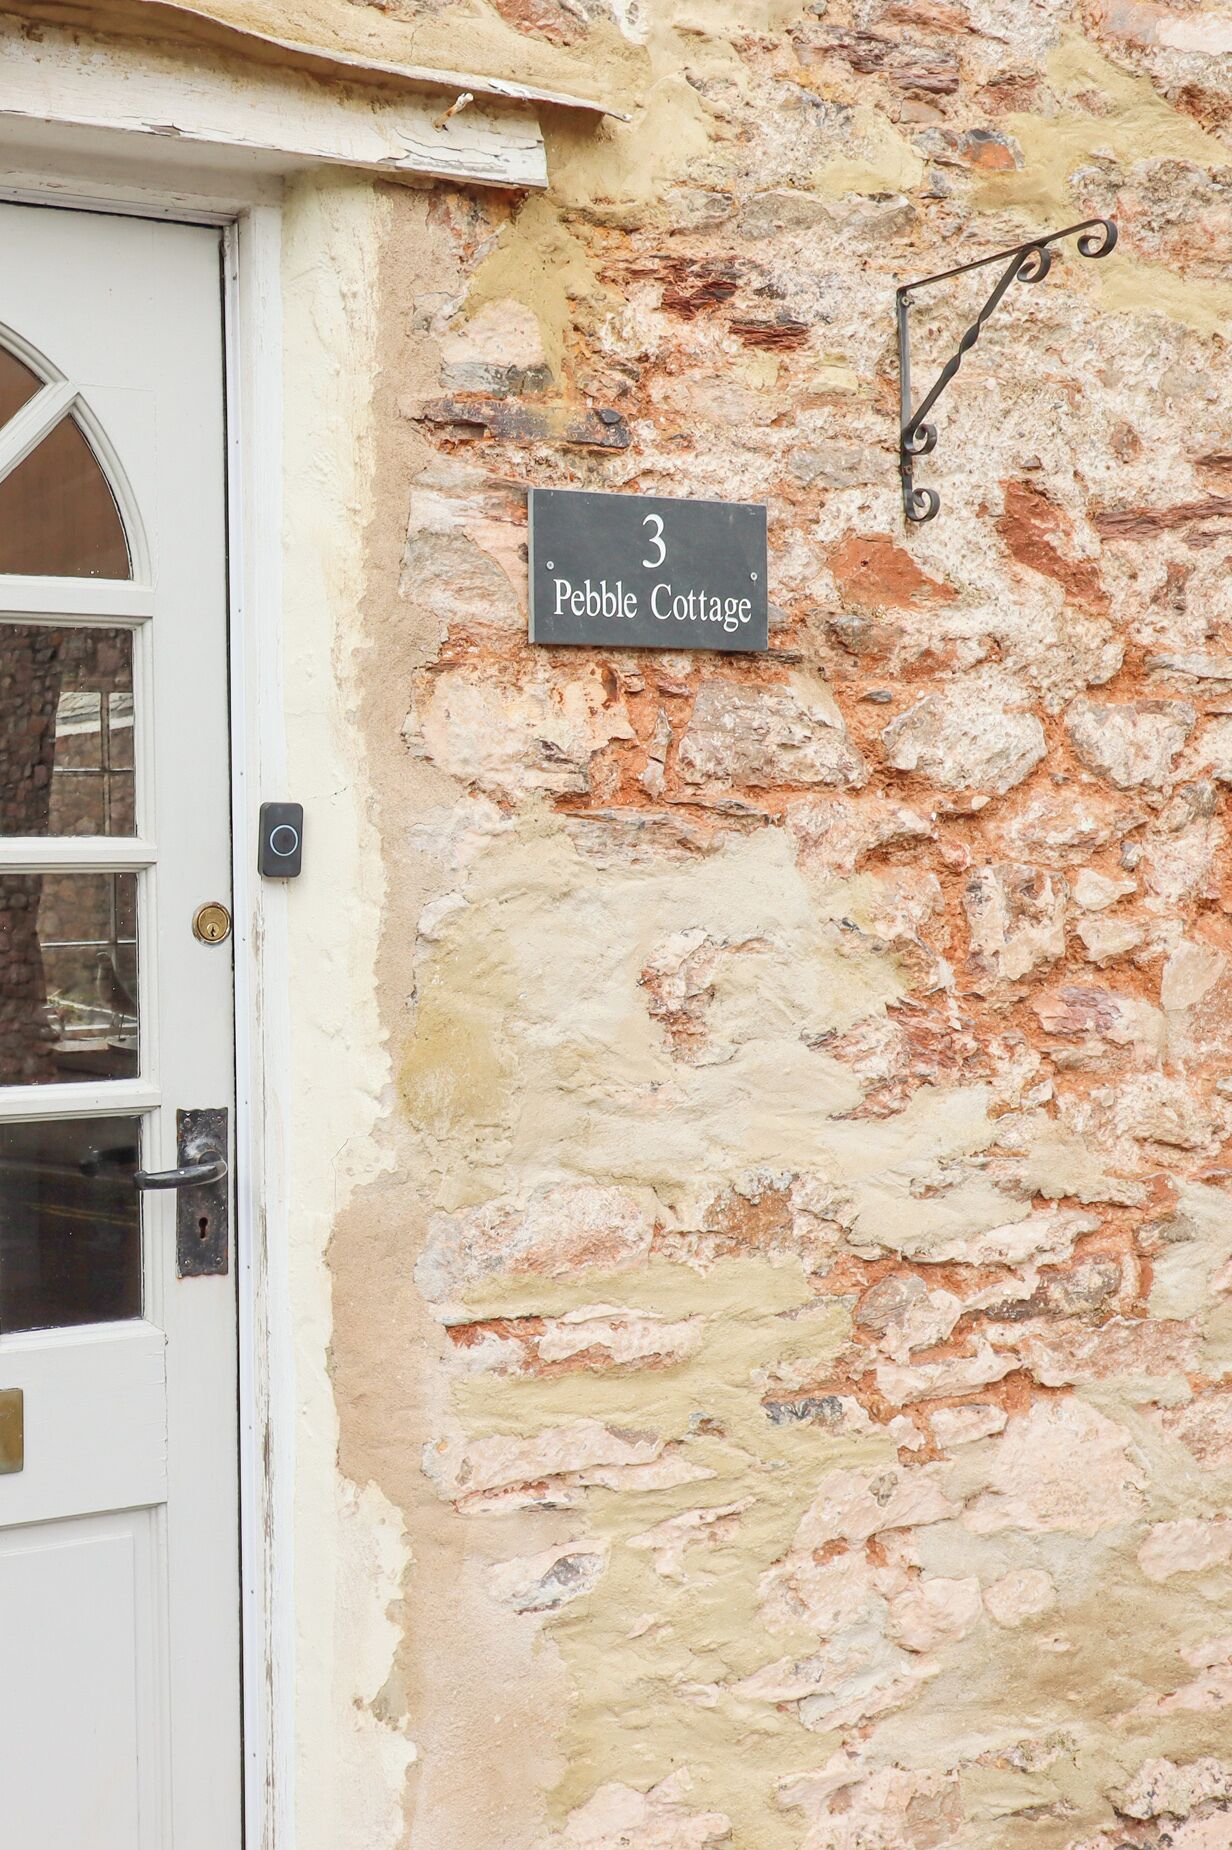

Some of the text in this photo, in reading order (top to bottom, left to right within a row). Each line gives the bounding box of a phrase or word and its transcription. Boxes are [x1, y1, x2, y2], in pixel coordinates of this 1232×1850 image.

[642, 513, 667, 569] 3
[553, 578, 752, 633] Pebble Cottage
